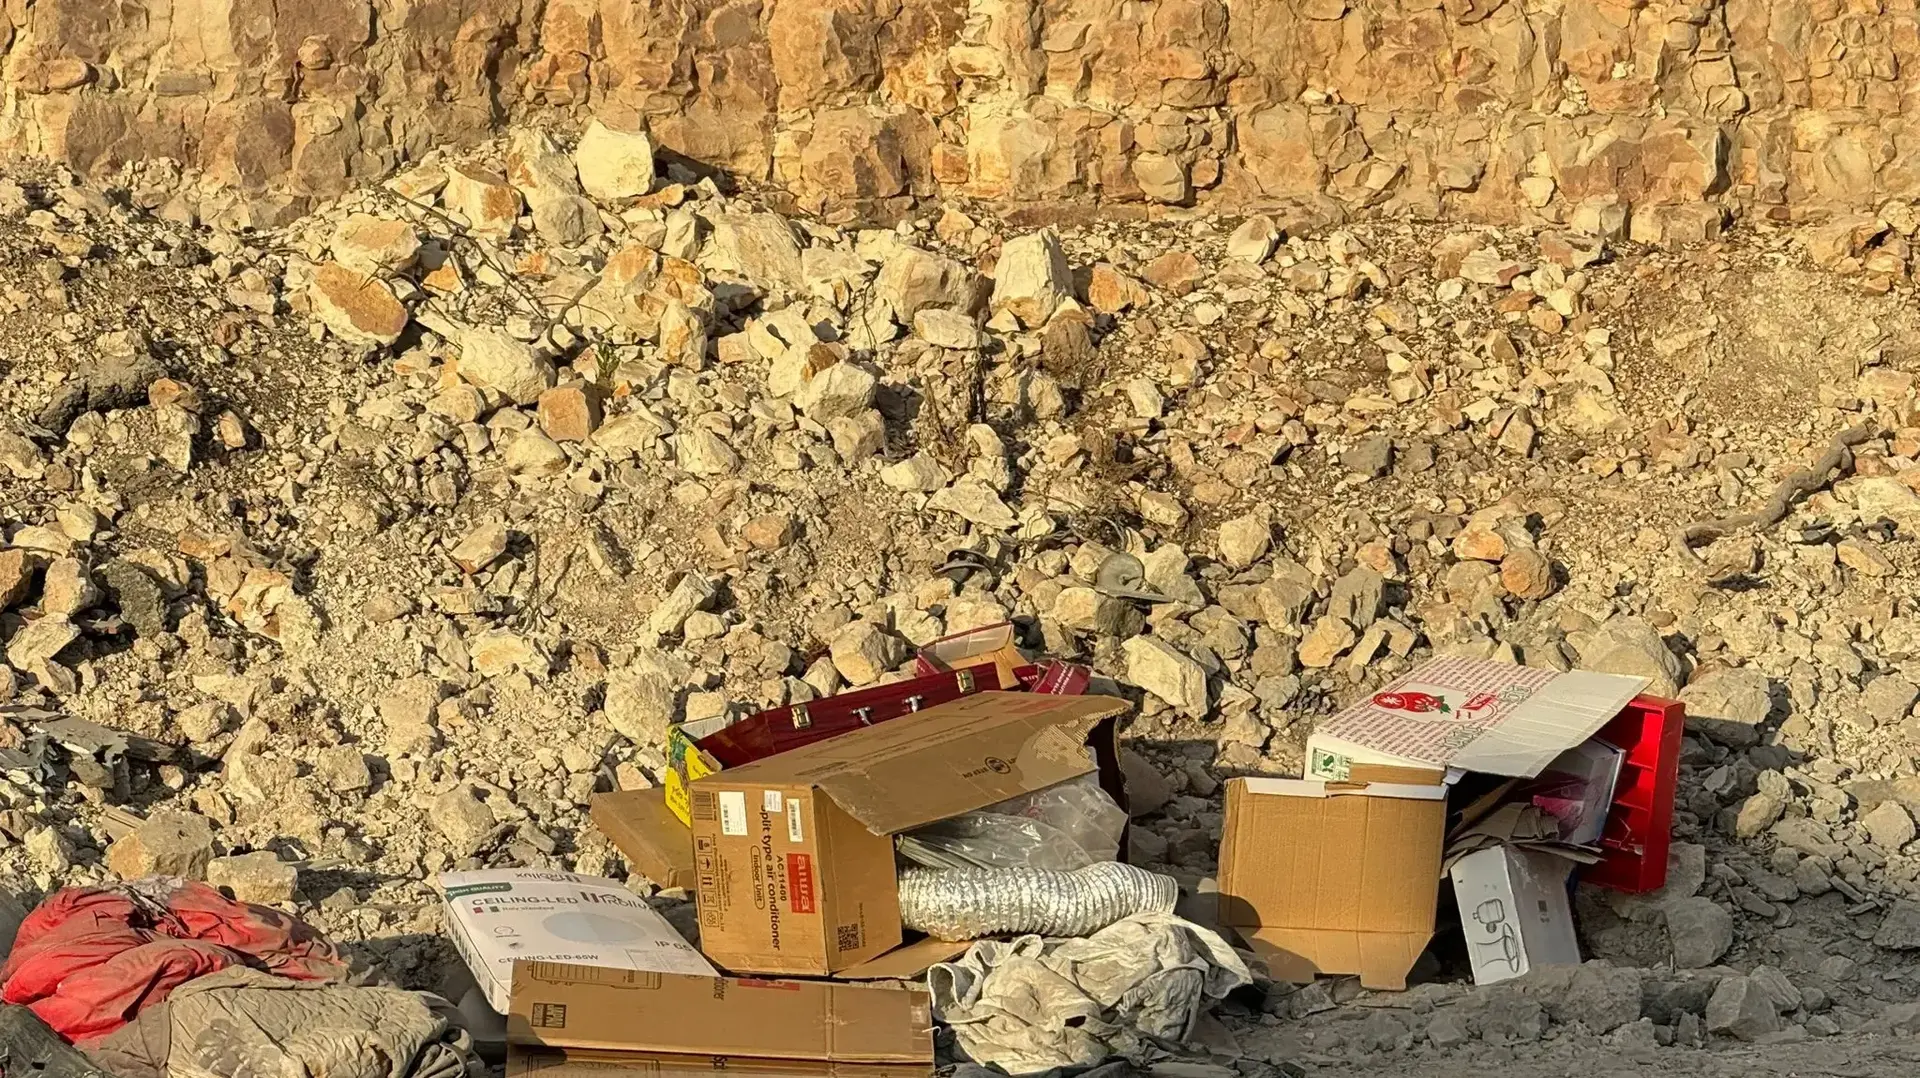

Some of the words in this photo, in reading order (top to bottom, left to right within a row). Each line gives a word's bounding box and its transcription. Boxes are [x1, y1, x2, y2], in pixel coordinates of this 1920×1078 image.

[761, 834, 772, 862] type
[753, 854, 761, 882] Indoor
[766, 862, 775, 881] air
[756, 882, 764, 902] Unit
[796, 855, 810, 912] aiwa
[472, 896, 579, 905] CEILING-LED
[767, 883, 780, 951] conditioner
